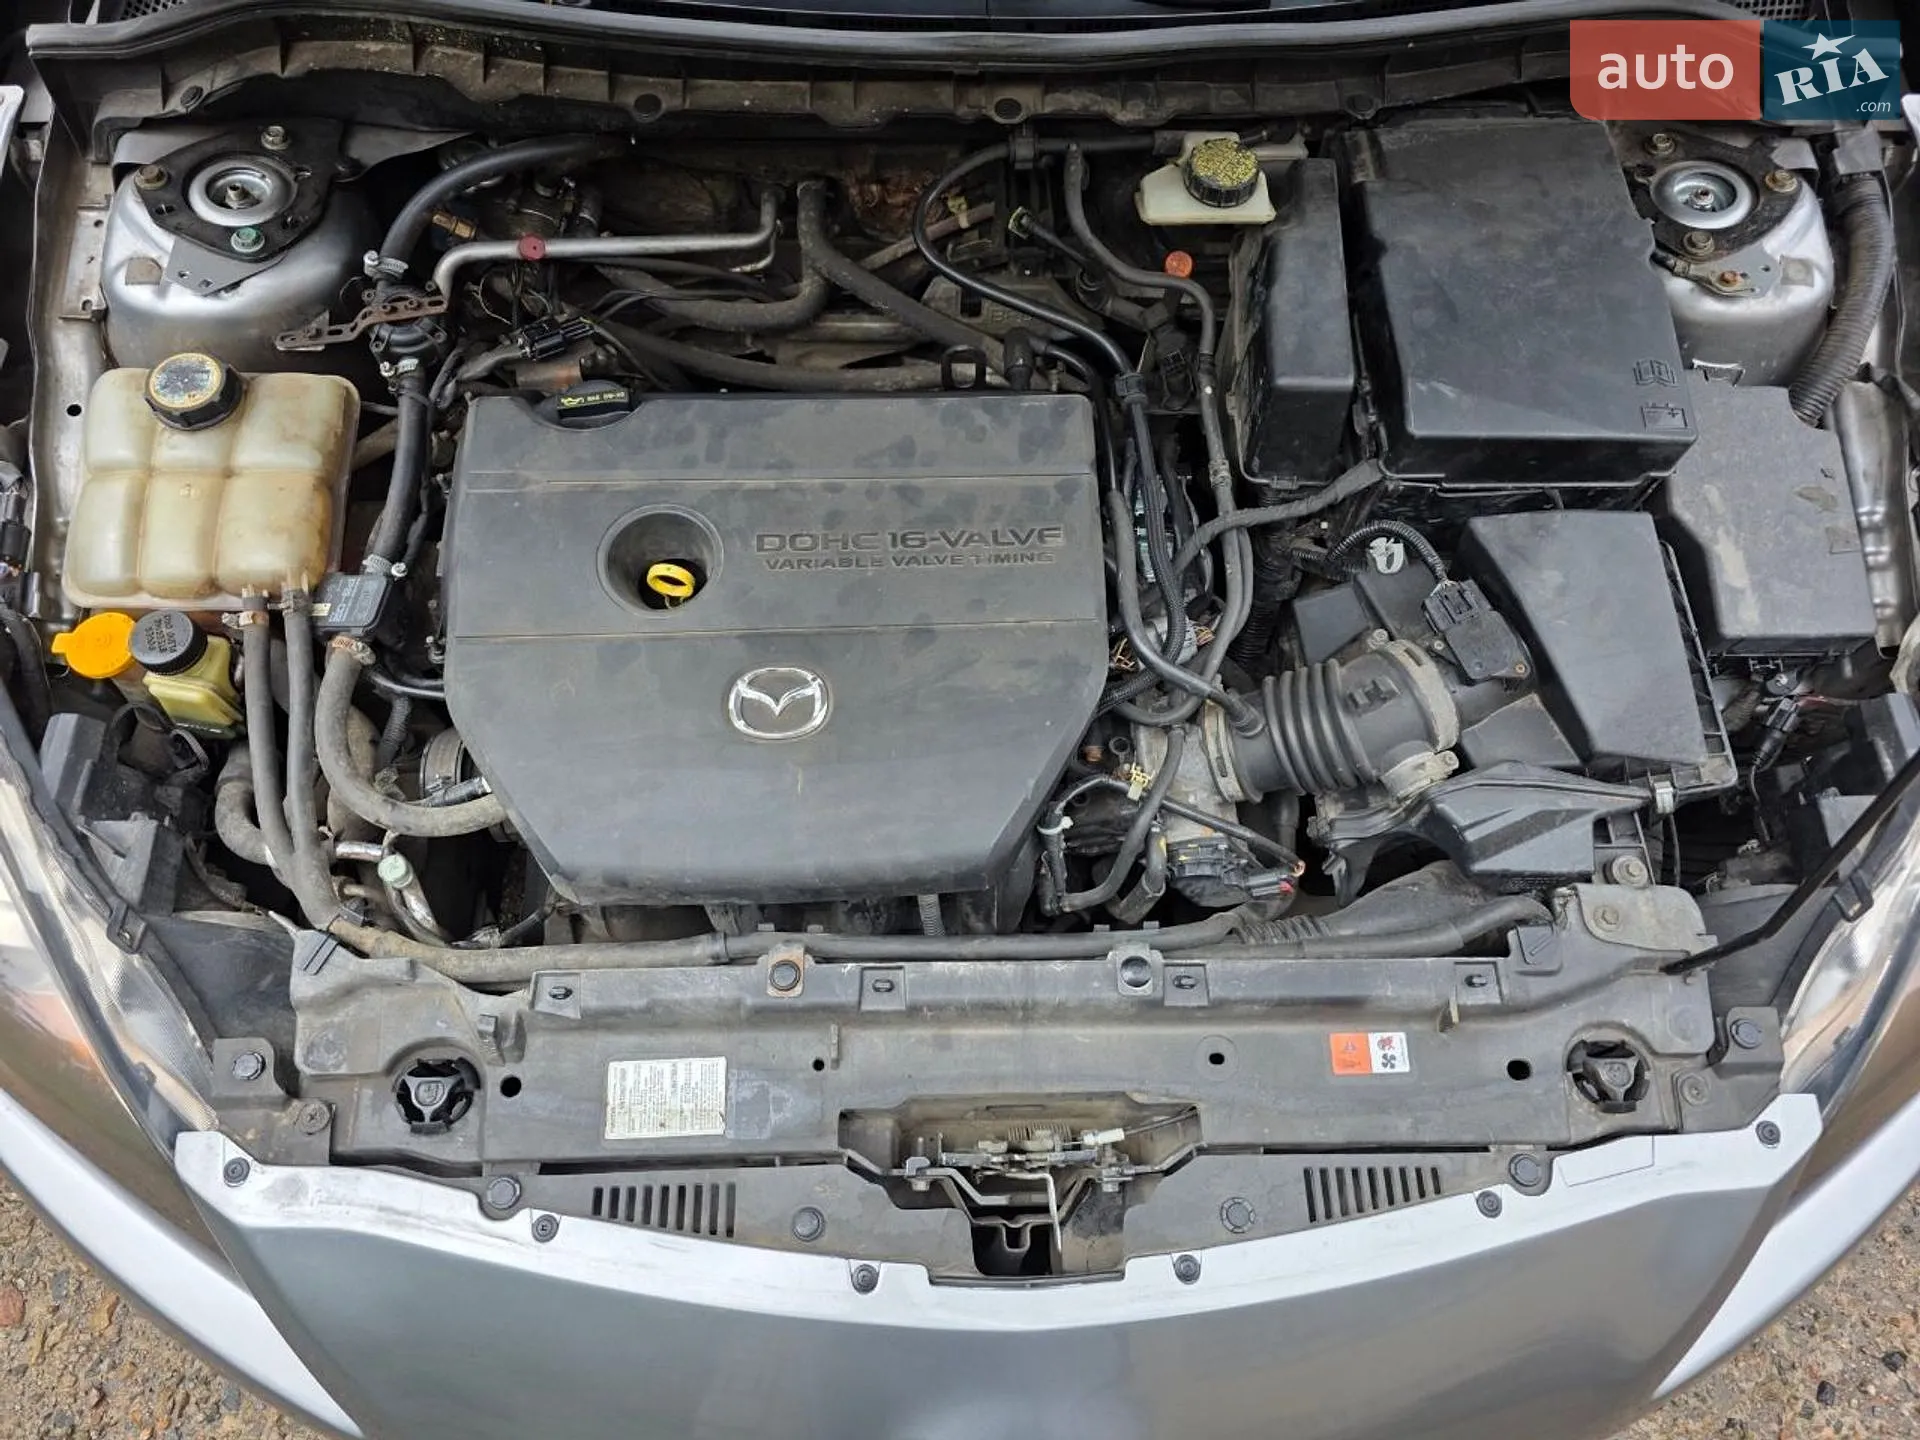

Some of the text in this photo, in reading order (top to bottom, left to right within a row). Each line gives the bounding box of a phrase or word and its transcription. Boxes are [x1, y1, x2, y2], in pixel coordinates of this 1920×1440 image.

[756, 526, 1064, 553] DOHC 16-VALVE
[765, 551, 1056, 571] VARIABLE VALVE TIMING
